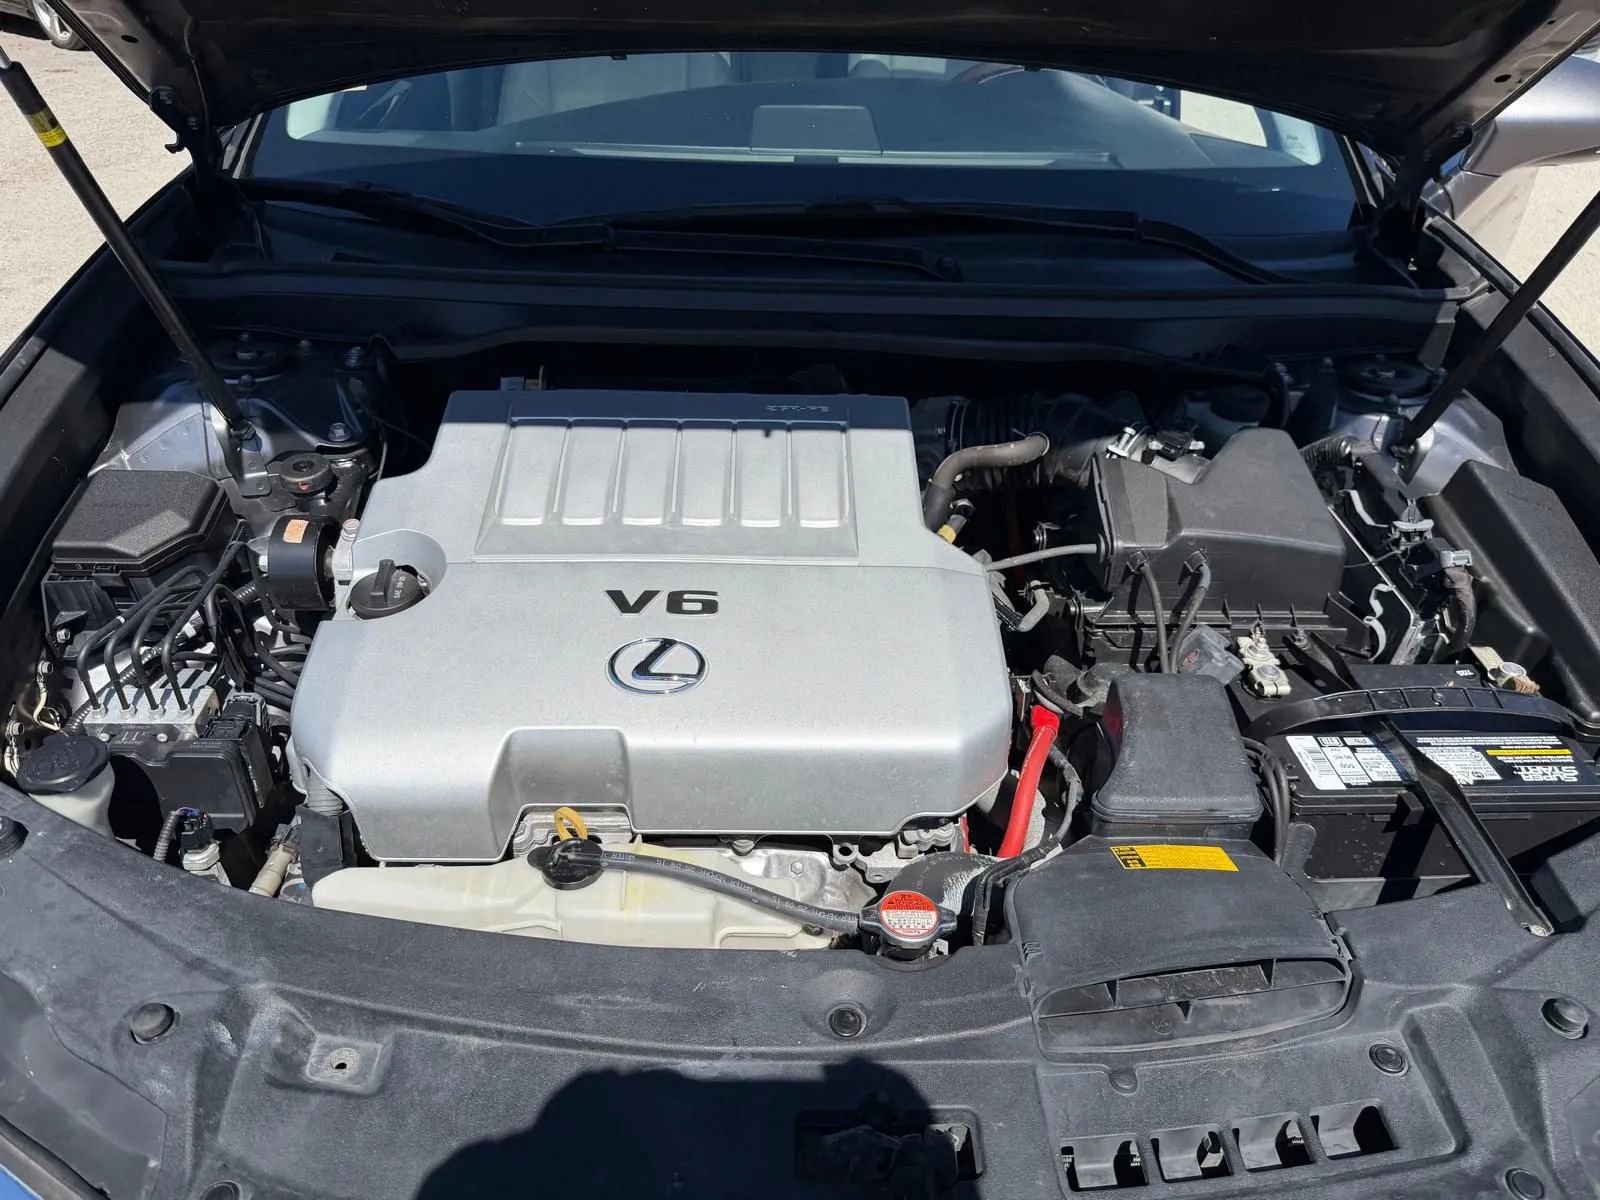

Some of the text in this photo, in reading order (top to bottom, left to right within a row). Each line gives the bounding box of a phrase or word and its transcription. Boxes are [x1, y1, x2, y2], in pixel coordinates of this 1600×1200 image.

[604, 589, 719, 615] V6
[1516, 766, 1579, 775] START
[1520, 774, 1578, 782] SUPER
